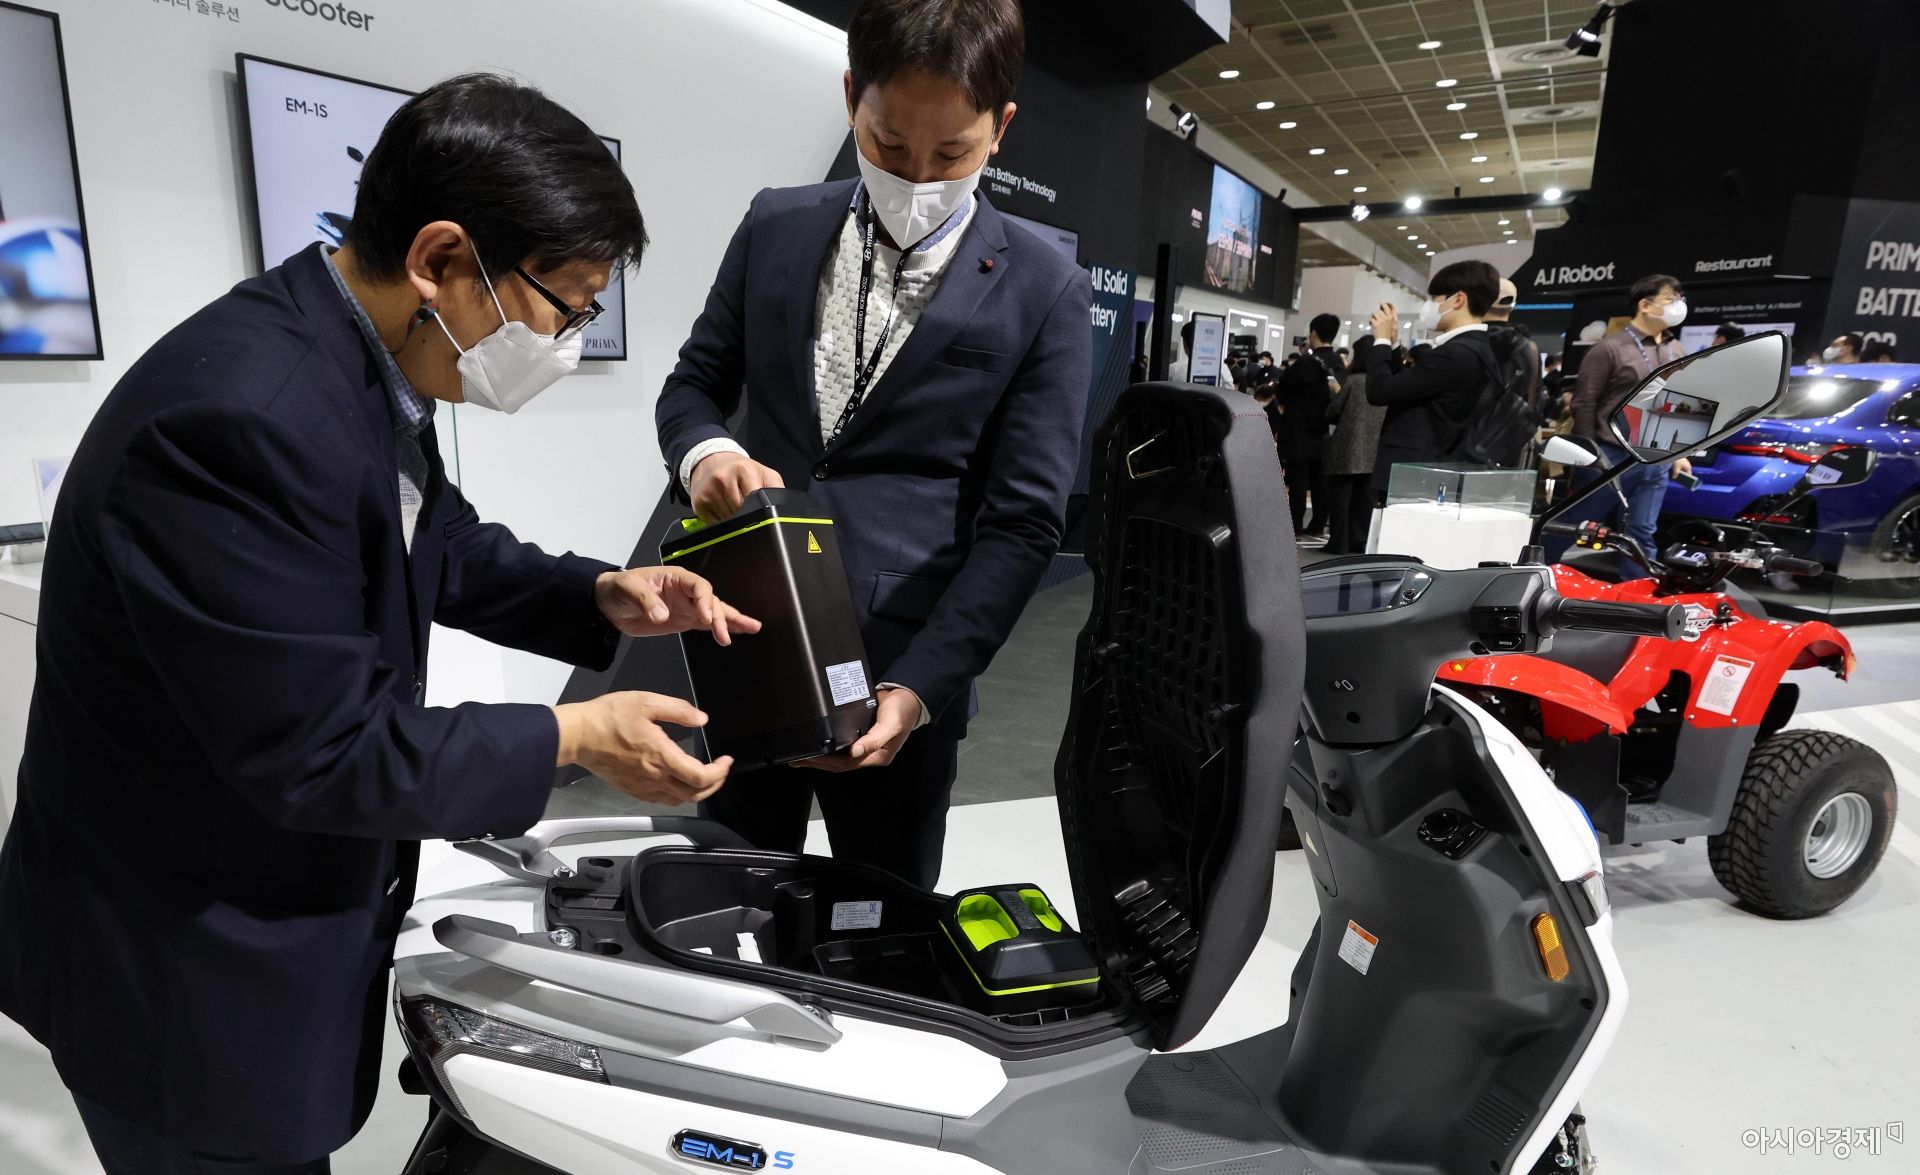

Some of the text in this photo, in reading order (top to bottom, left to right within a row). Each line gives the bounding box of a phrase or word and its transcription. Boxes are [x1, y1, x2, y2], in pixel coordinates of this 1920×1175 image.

[264, 0, 375, 32] cooter
[285, 97, 328, 118] EM-1S
[996, 167, 1021, 191] Battery
[1022, 177, 1056, 203] Technology
[1558, 261, 1615, 285] Robot
[1695, 254, 1772, 273] Restaurant
[1103, 269, 1128, 296] Solid
[1090, 302, 1117, 336] ttery
[681, 1137, 796, 1170] EM-1 S
